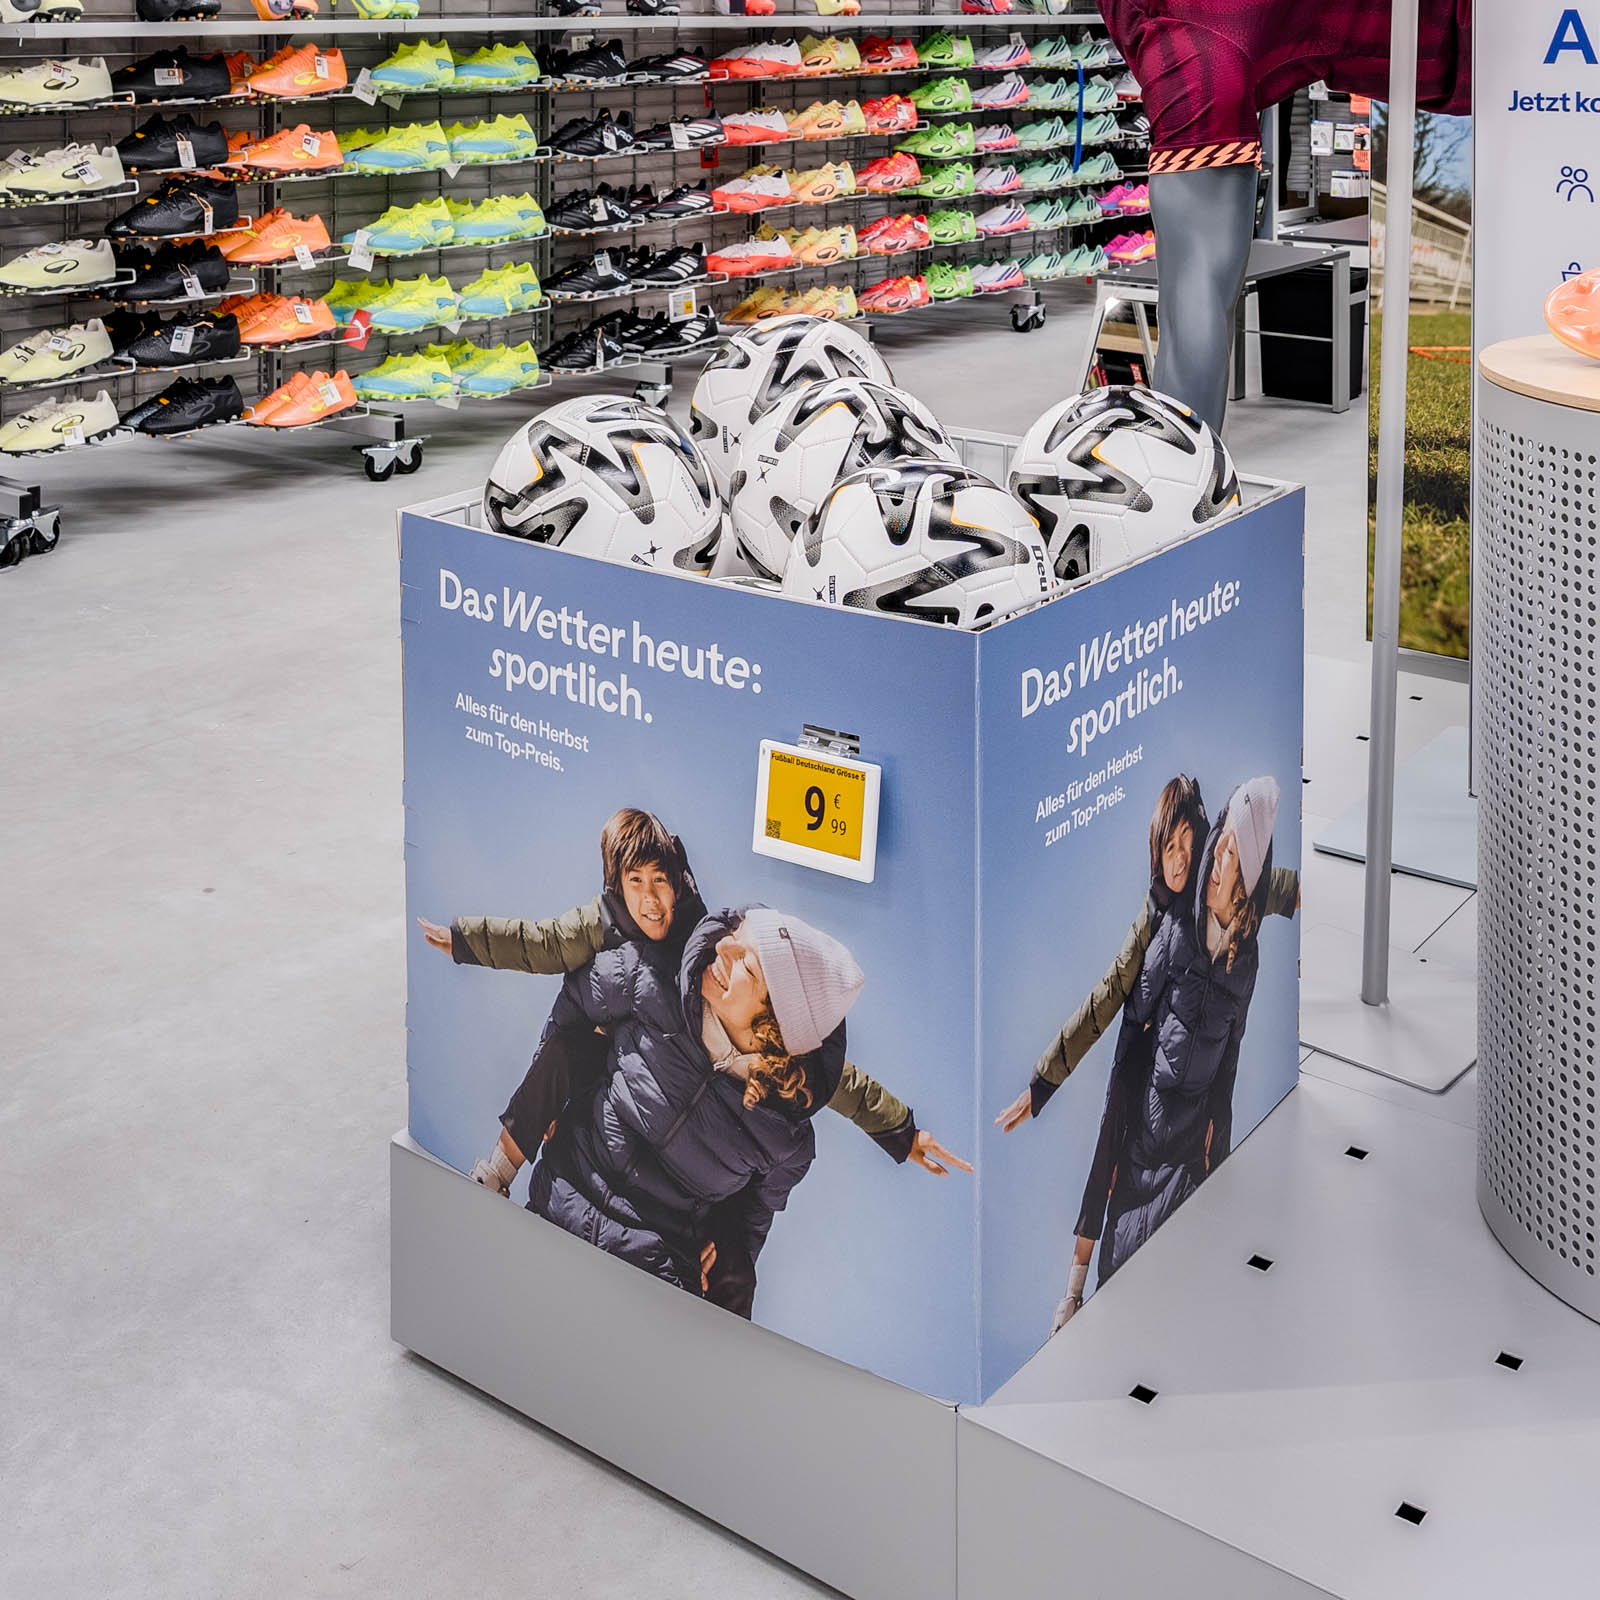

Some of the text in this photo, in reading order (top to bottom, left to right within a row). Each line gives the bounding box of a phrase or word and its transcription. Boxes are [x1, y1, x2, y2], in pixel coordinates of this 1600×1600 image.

[1507, 90, 1572, 113] Jetzt
[439, 568, 762, 694] Das Wetter heute:
[1021, 580, 1241, 719] Das Wetter heute:
[488, 648, 653, 724] sportlich.
[1066, 656, 1184, 757] sportlich.
[455, 692, 590, 753] Alles für den Herbst
[465, 726, 565, 773] zum Top-Preis.
[771, 752, 795, 765] Fußball
[796, 760, 836, 775] Deutschland
[836, 769, 859, 780] Grösse
[1035, 743, 1144, 823] Alles für den Herbst
[804, 786, 841, 831] 9 €
[831, 818, 847, 836] 99
[1045, 784, 1126, 848] zum Top-Preis.
